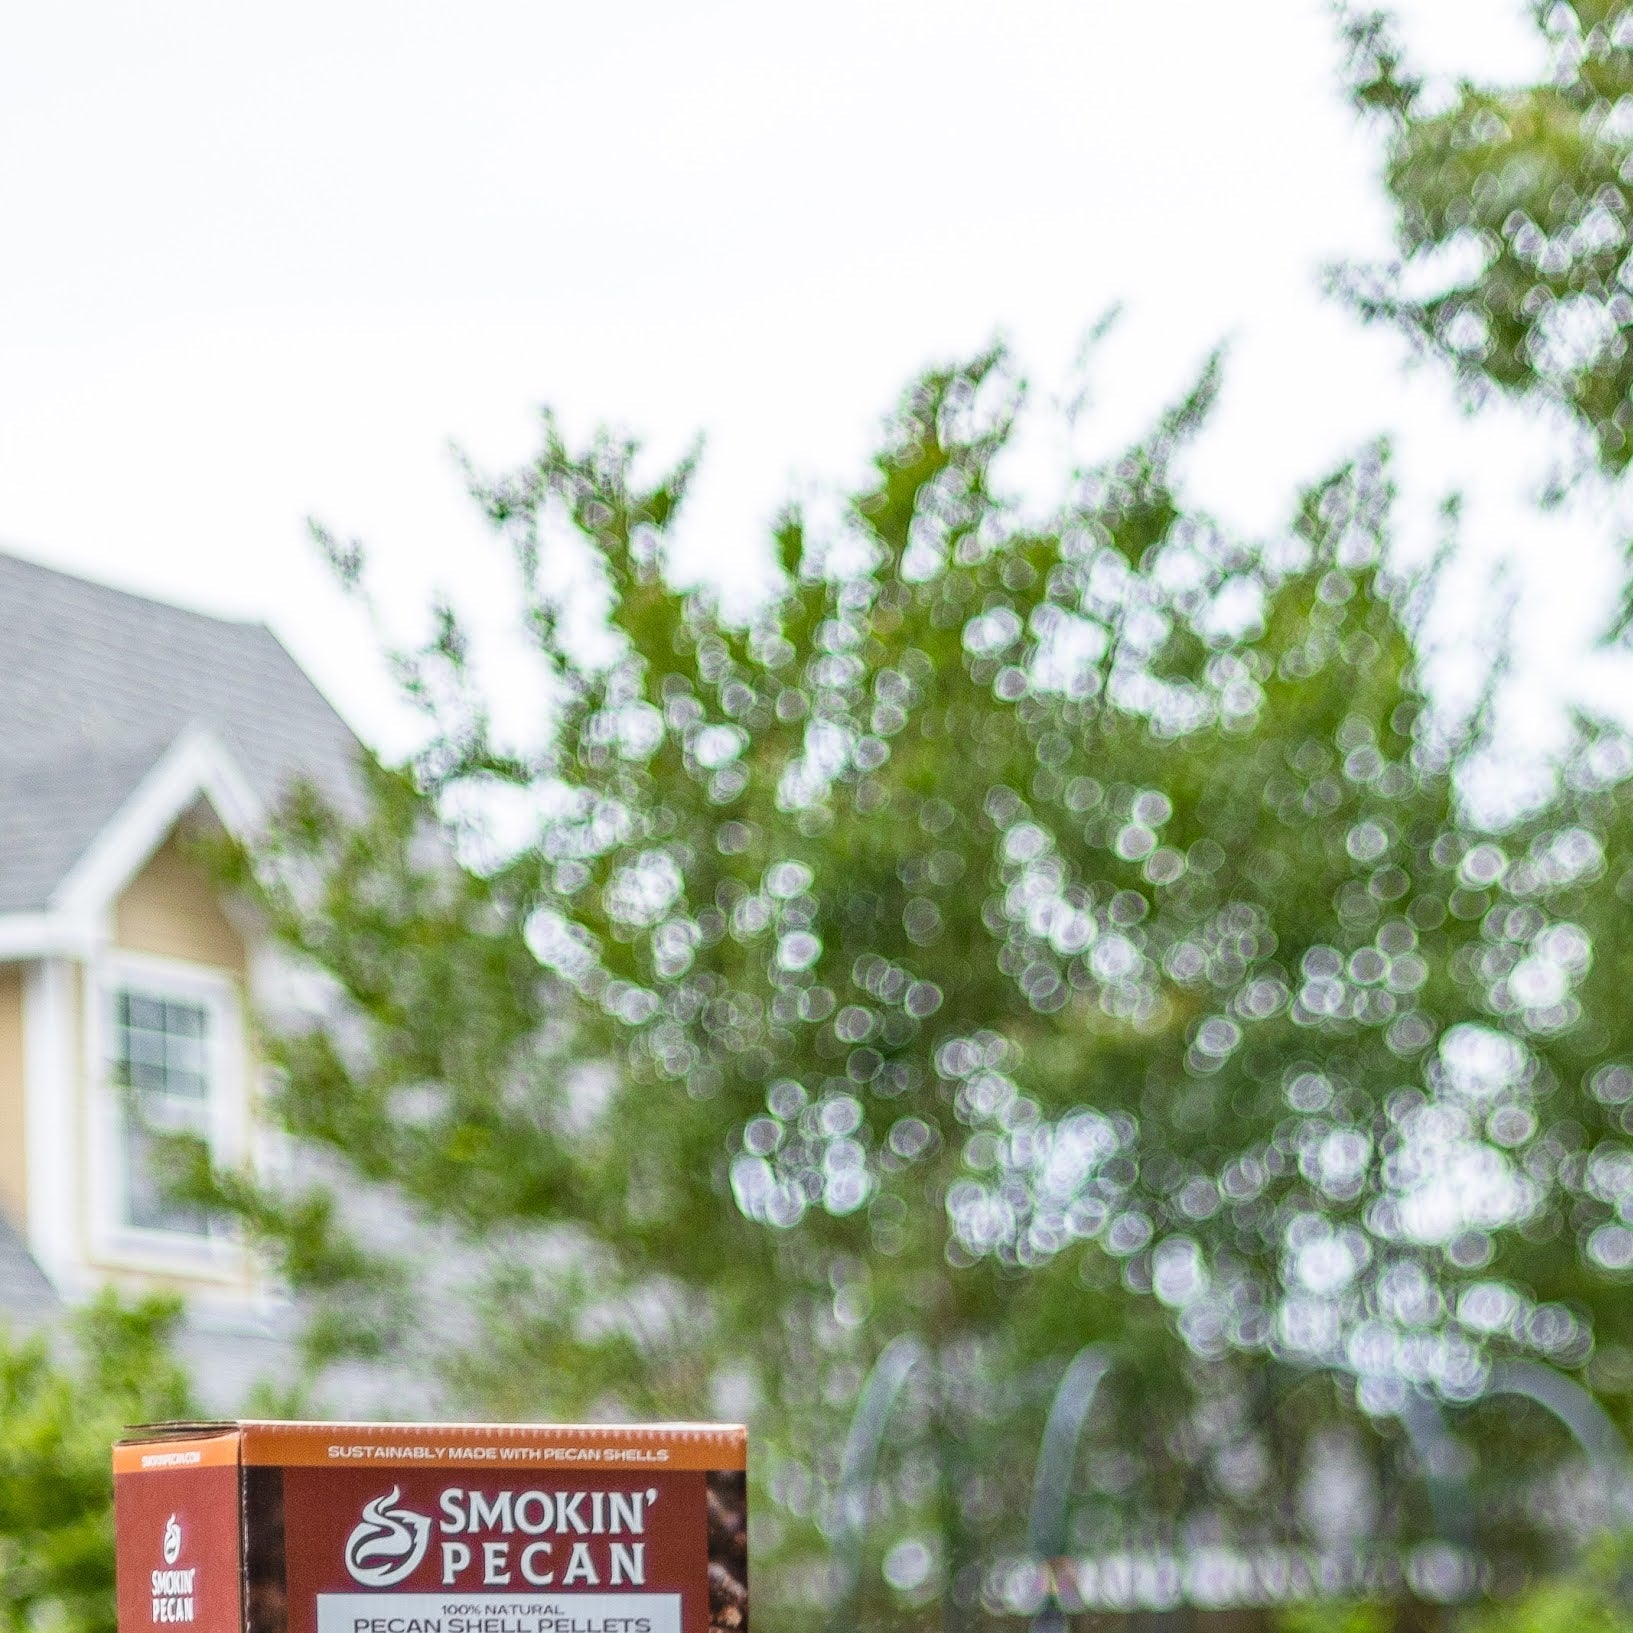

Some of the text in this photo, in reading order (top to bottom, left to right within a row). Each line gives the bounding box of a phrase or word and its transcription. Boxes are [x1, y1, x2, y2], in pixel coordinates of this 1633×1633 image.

[328, 1445, 670, 1462] SUSTAINABLY MADE WITH PECAN SHELLS
[441, 1541, 646, 1586] PECAN
[152, 1597, 194, 1623] PECAN
[441, 1604, 565, 1616] 100% NATURAL
[354, 1618, 651, 1633] PECAN SHELL PELLETS
